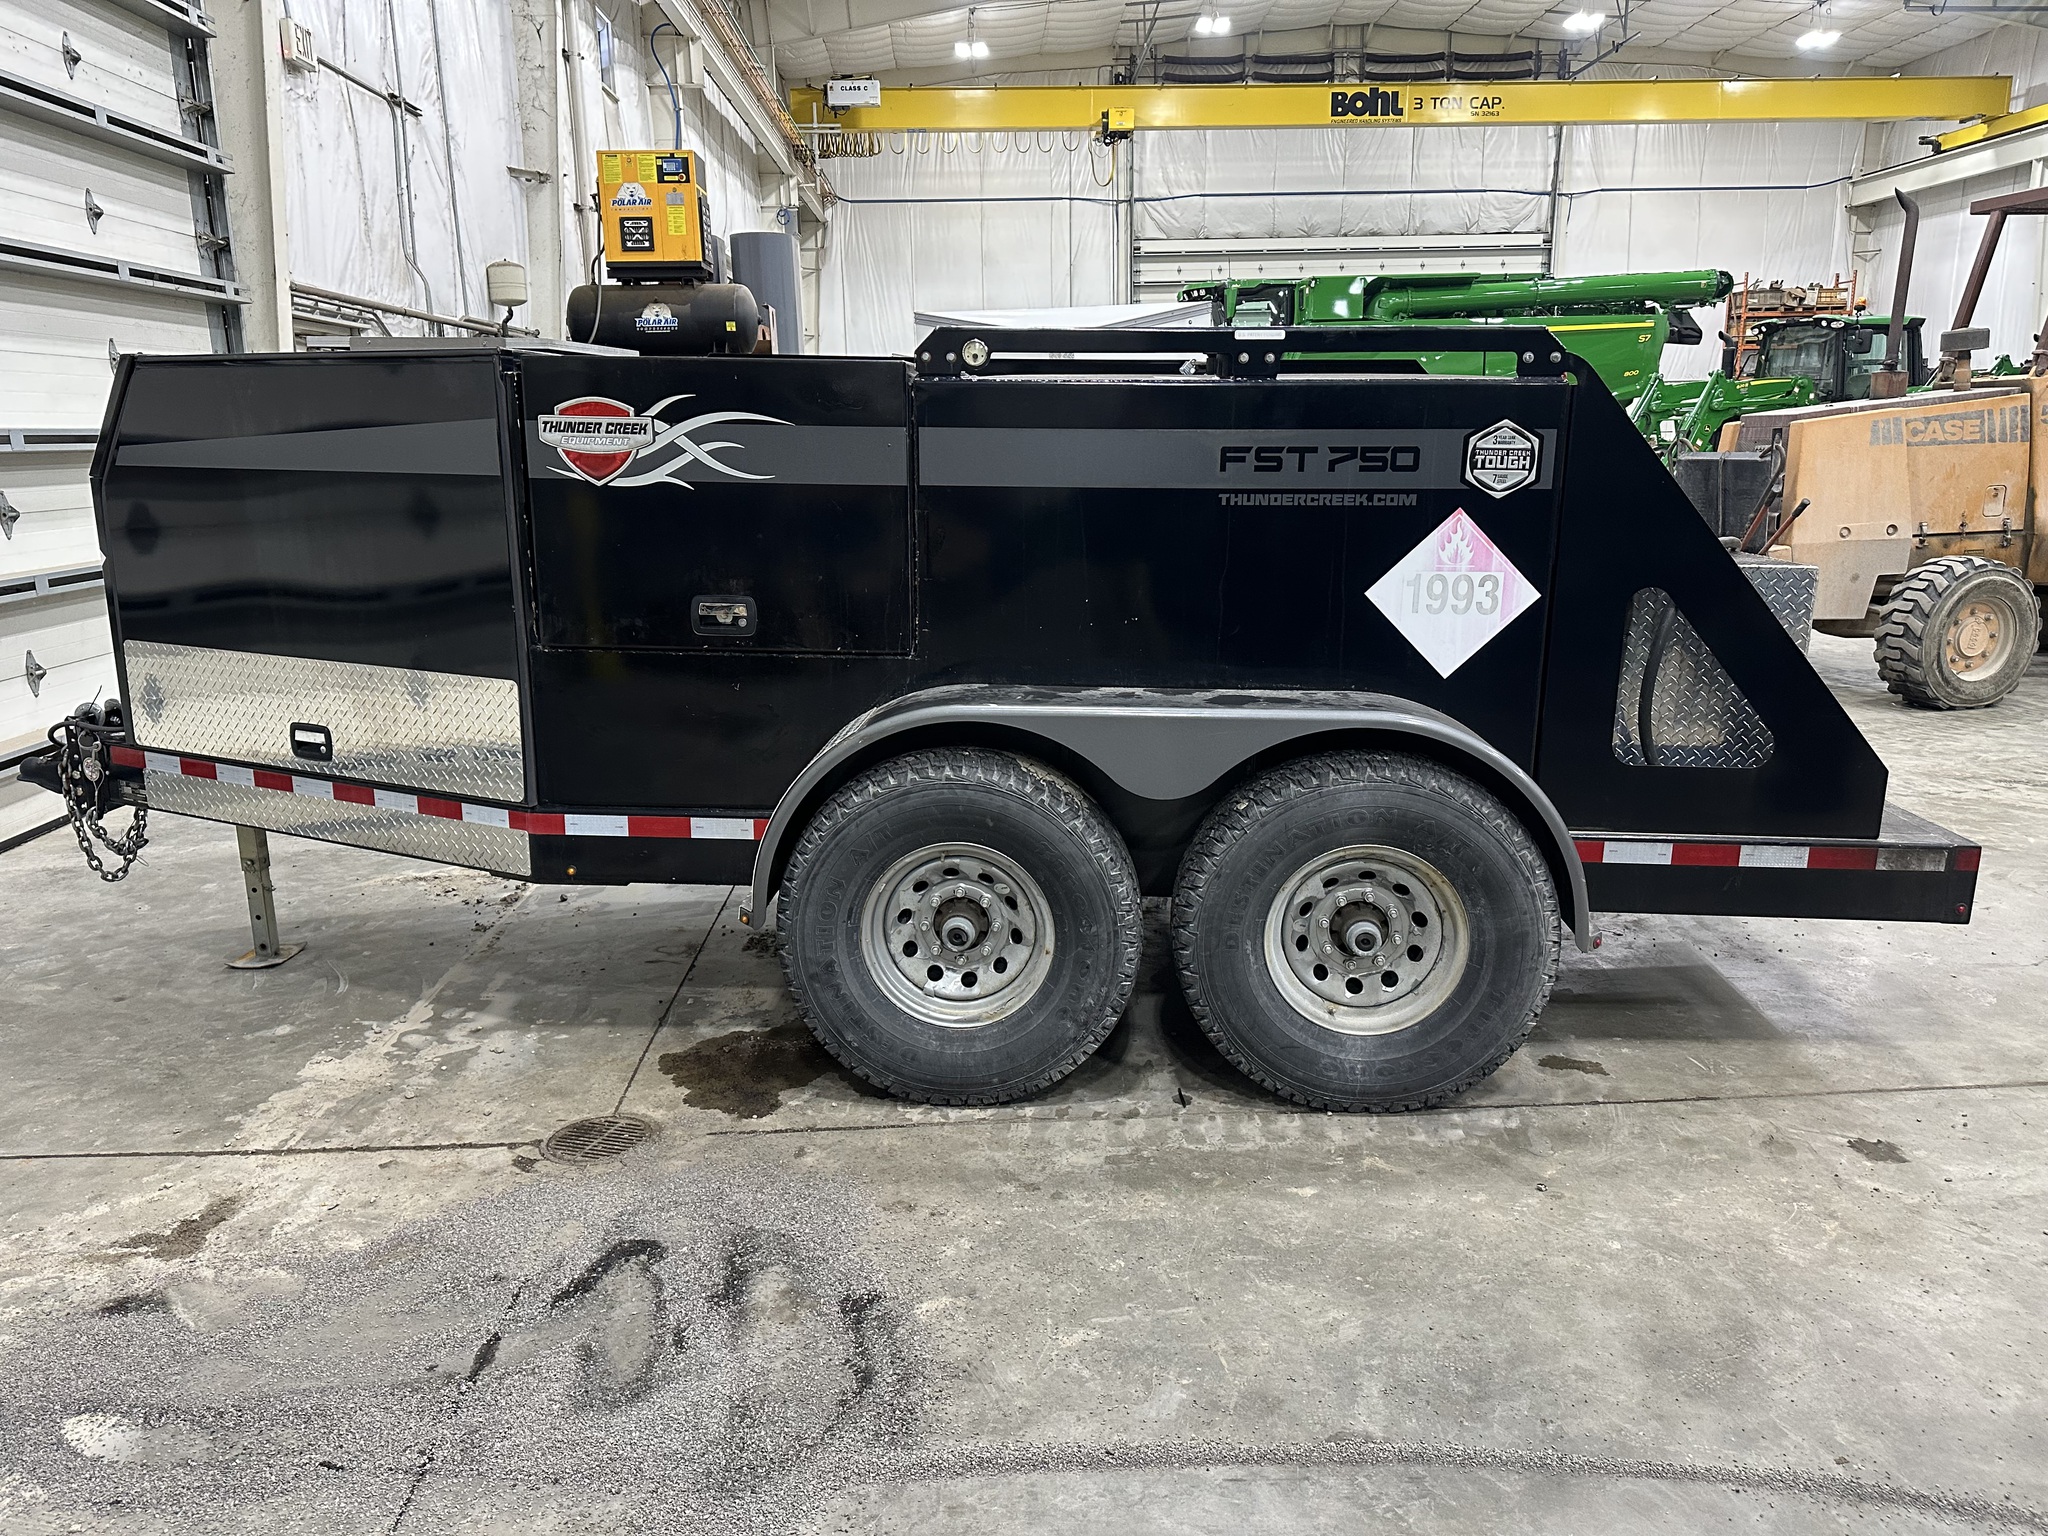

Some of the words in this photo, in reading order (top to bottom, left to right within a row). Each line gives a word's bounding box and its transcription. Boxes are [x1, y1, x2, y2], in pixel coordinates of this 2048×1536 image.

[294, 23, 313, 61] EXIT
[1413, 97, 1424, 110] 3
[1430, 97, 1463, 110] TON
[1469, 97, 1505, 110] CAP.
[612, 198, 637, 206] POLAR
[638, 198, 652, 206] AIR
[1638, 334, 1652, 343] S7
[1623, 369, 1640, 378] 800
[541, 421, 603, 434] THUNDER
[604, 422, 649, 435] CREEK
[1906, 418, 1982, 443] CASE
[561, 436, 630, 446] EQUIPMENT
[1493, 435, 1498, 445] 3
[1219, 446, 1319, 473] FST
[1327, 446, 1421, 473] 750
[1475, 455, 1530, 469] TOUGH
[1492, 474, 1498, 484] 7
[1218, 493, 1418, 506] THUNDERCREEK.COM
[1406, 573, 1500, 616] 1993
[1223, 807, 1399, 951] DESTINATION
